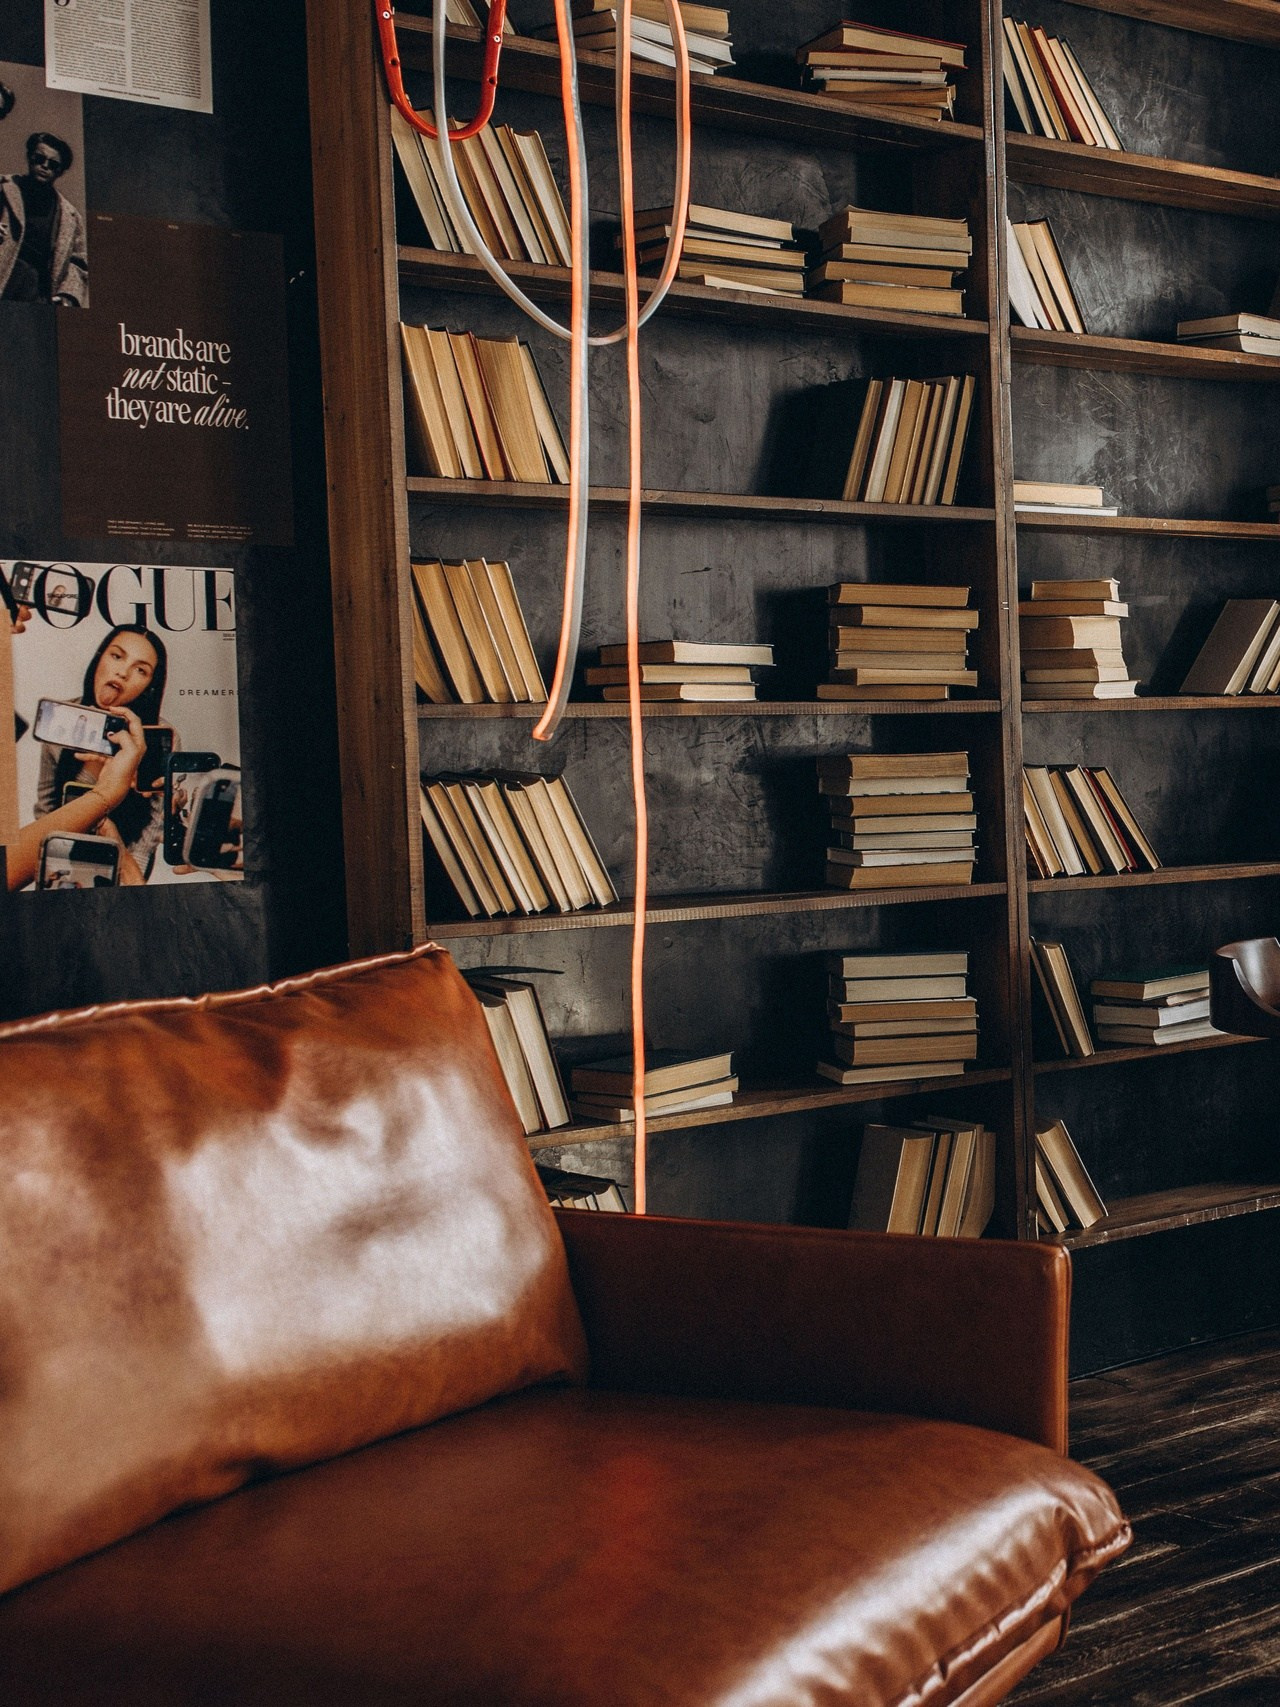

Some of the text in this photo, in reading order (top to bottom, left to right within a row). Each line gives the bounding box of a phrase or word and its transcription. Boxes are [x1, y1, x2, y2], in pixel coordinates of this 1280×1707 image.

[118, 322, 231, 364] brands are
[121, 362, 167, 391] not
[166, 365, 218, 395] static
[105, 386, 249, 430] they are alive.
